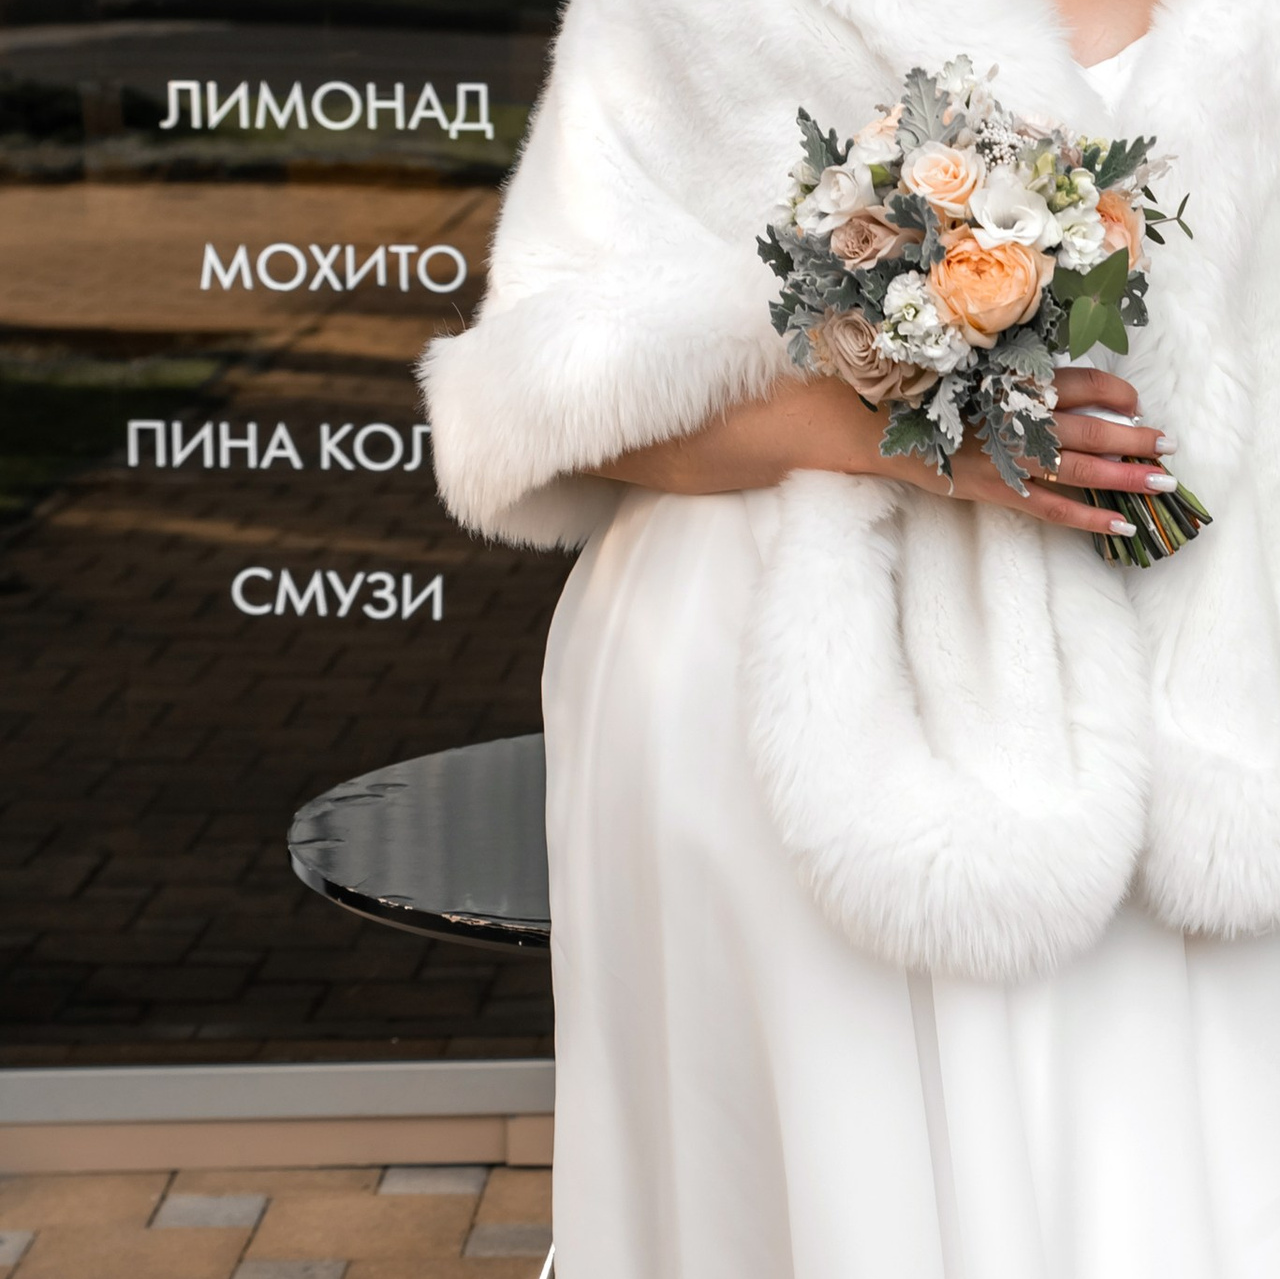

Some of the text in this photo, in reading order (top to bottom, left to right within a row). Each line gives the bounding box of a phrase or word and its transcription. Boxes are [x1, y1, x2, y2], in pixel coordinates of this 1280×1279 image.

[159, 80, 496, 140] ЛИМОНАД
[199, 242, 468, 293] МОХИТО
[126, 419, 304, 471] ПИНА
[230, 566, 445, 621] СМУЗИ
